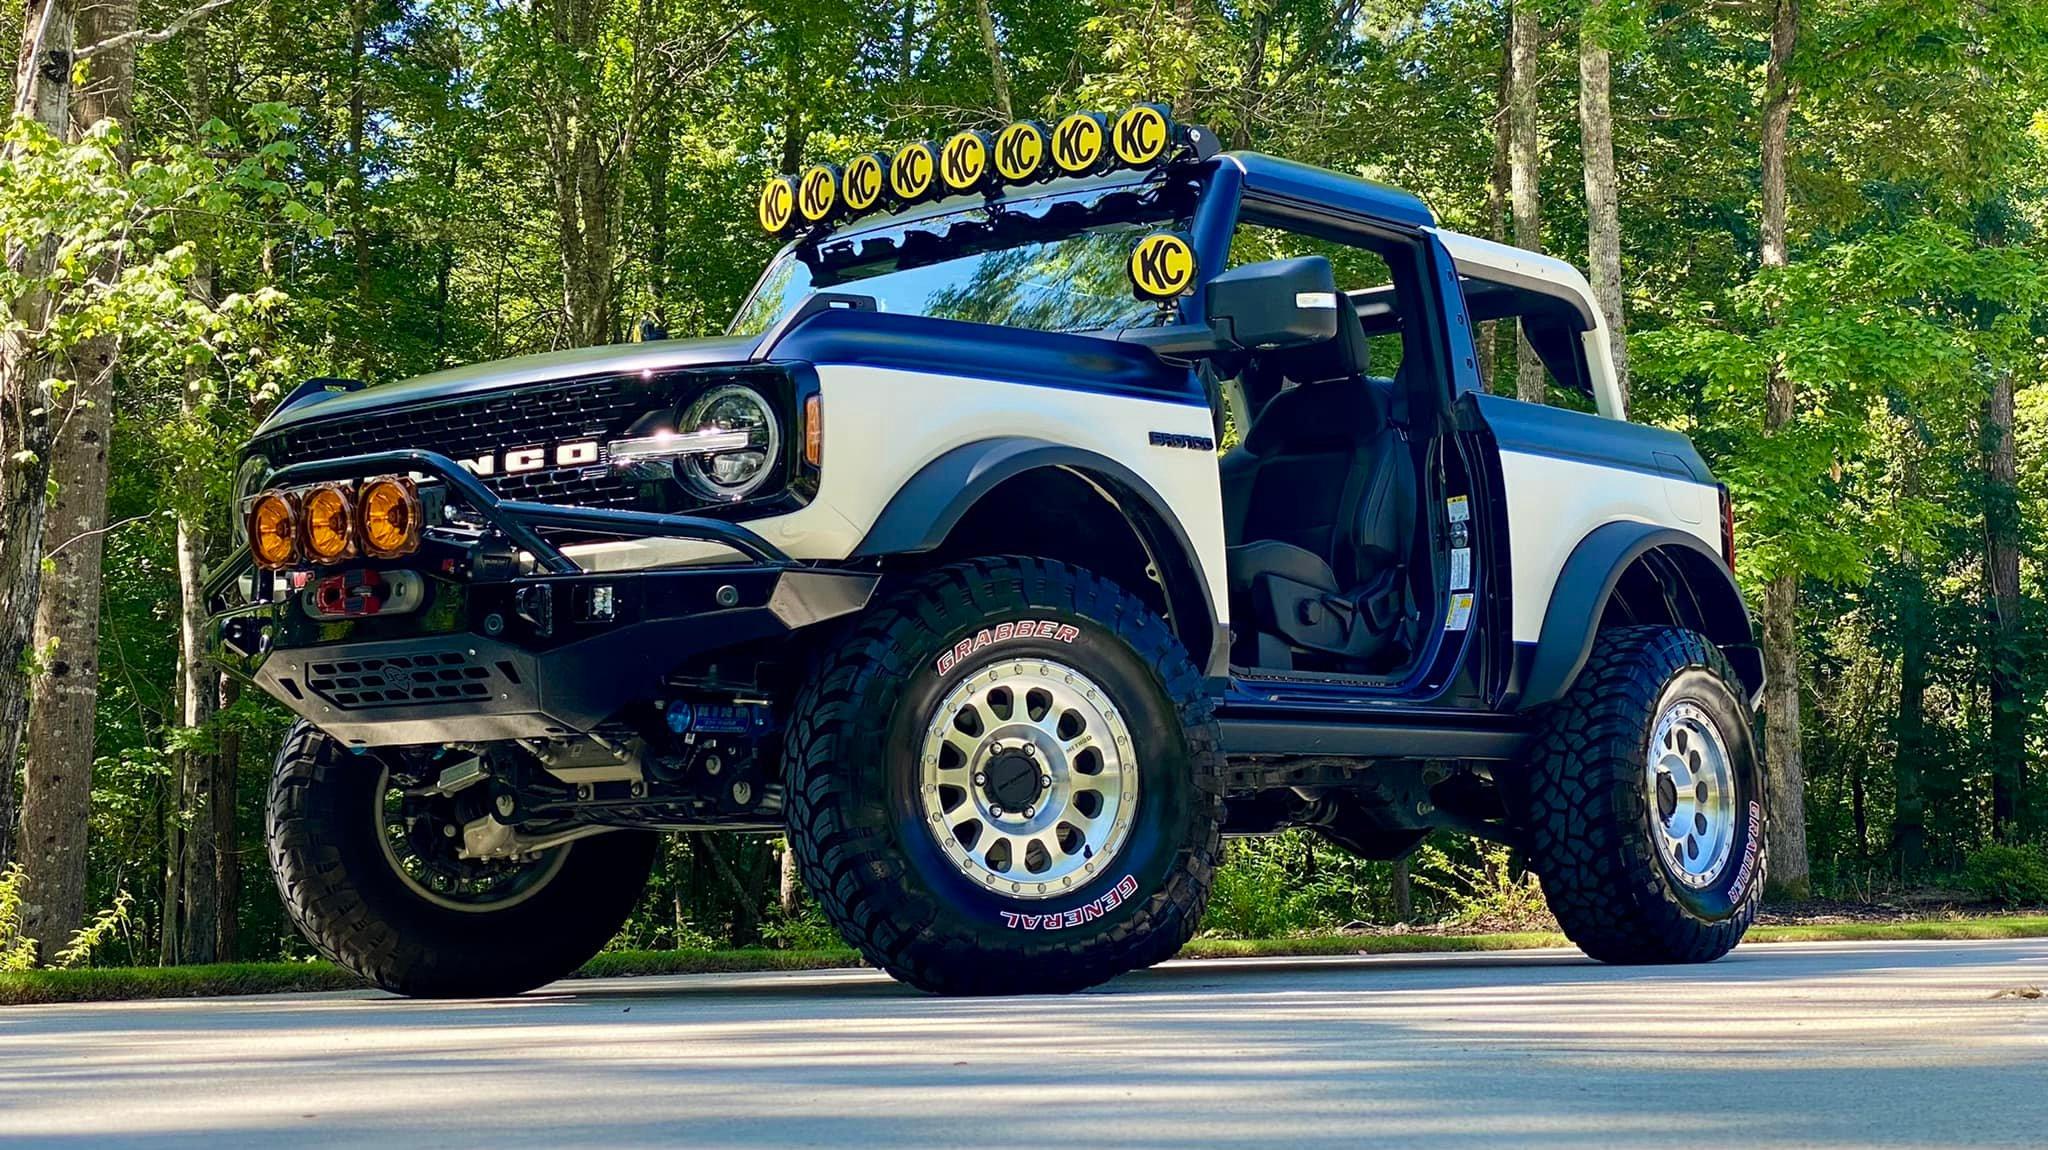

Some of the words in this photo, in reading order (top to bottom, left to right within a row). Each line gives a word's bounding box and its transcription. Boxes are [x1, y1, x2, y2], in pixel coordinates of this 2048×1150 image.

[1002, 128, 1035, 174] KC
[1058, 119, 1095, 166] KC
[1120, 111, 1158, 161] KC
[849, 160, 876, 204] KC
[897, 149, 926, 193] KC
[948, 138, 979, 183] KC
[765, 184, 787, 226] KC
[805, 171, 829, 215] KC
[1140, 240, 1184, 290] KC
[936, 620, 1080, 676] GRABBER
[1727, 800, 1761, 905] GRABBER
[1000, 874, 1139, 930] GENERAL
